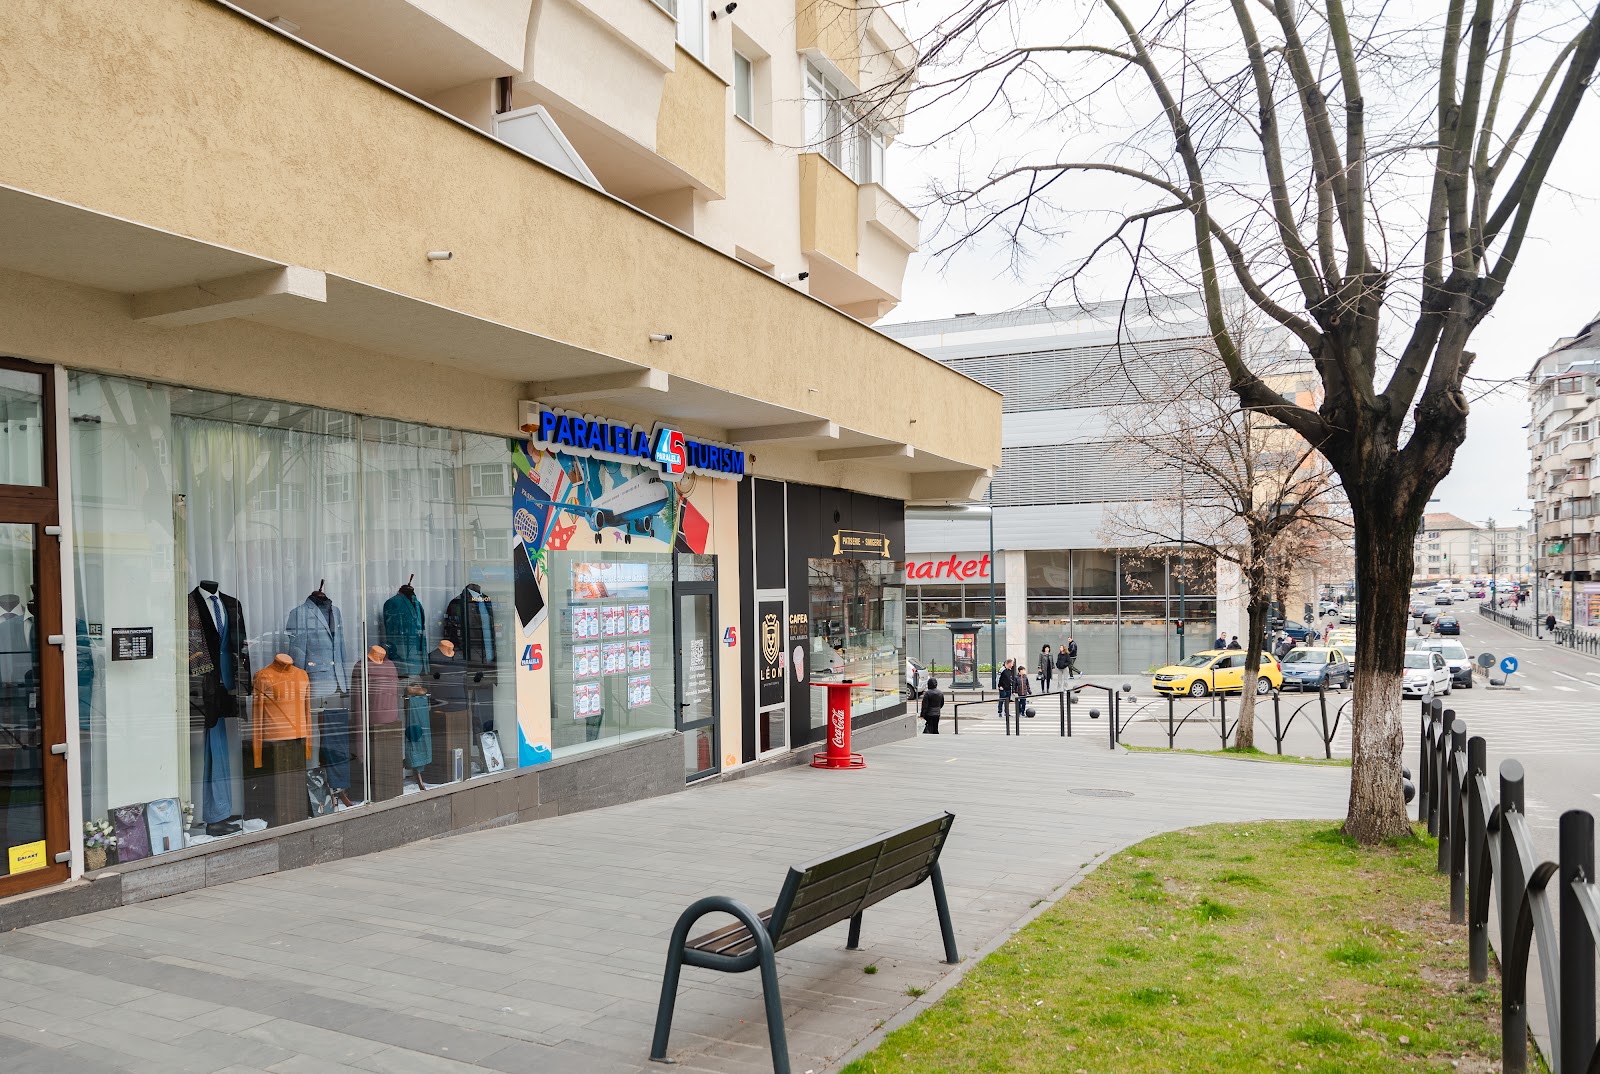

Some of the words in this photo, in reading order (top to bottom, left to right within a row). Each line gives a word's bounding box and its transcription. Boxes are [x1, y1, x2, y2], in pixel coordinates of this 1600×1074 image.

[539, 411, 652, 459] PARALELA
[654, 428, 687, 474] 45
[656, 452, 681, 464] PARALELA
[686, 441, 745, 475] TURISM
[789, 614, 808, 625] CAFEA
[790, 624, 798, 635] TO
[799, 624, 808, 635] GO
[723, 626, 737, 647] 45
[521, 643, 543, 671] 45
[760, 666, 783, 681] LÉON
[832, 708, 845, 748] Coca-Cola
